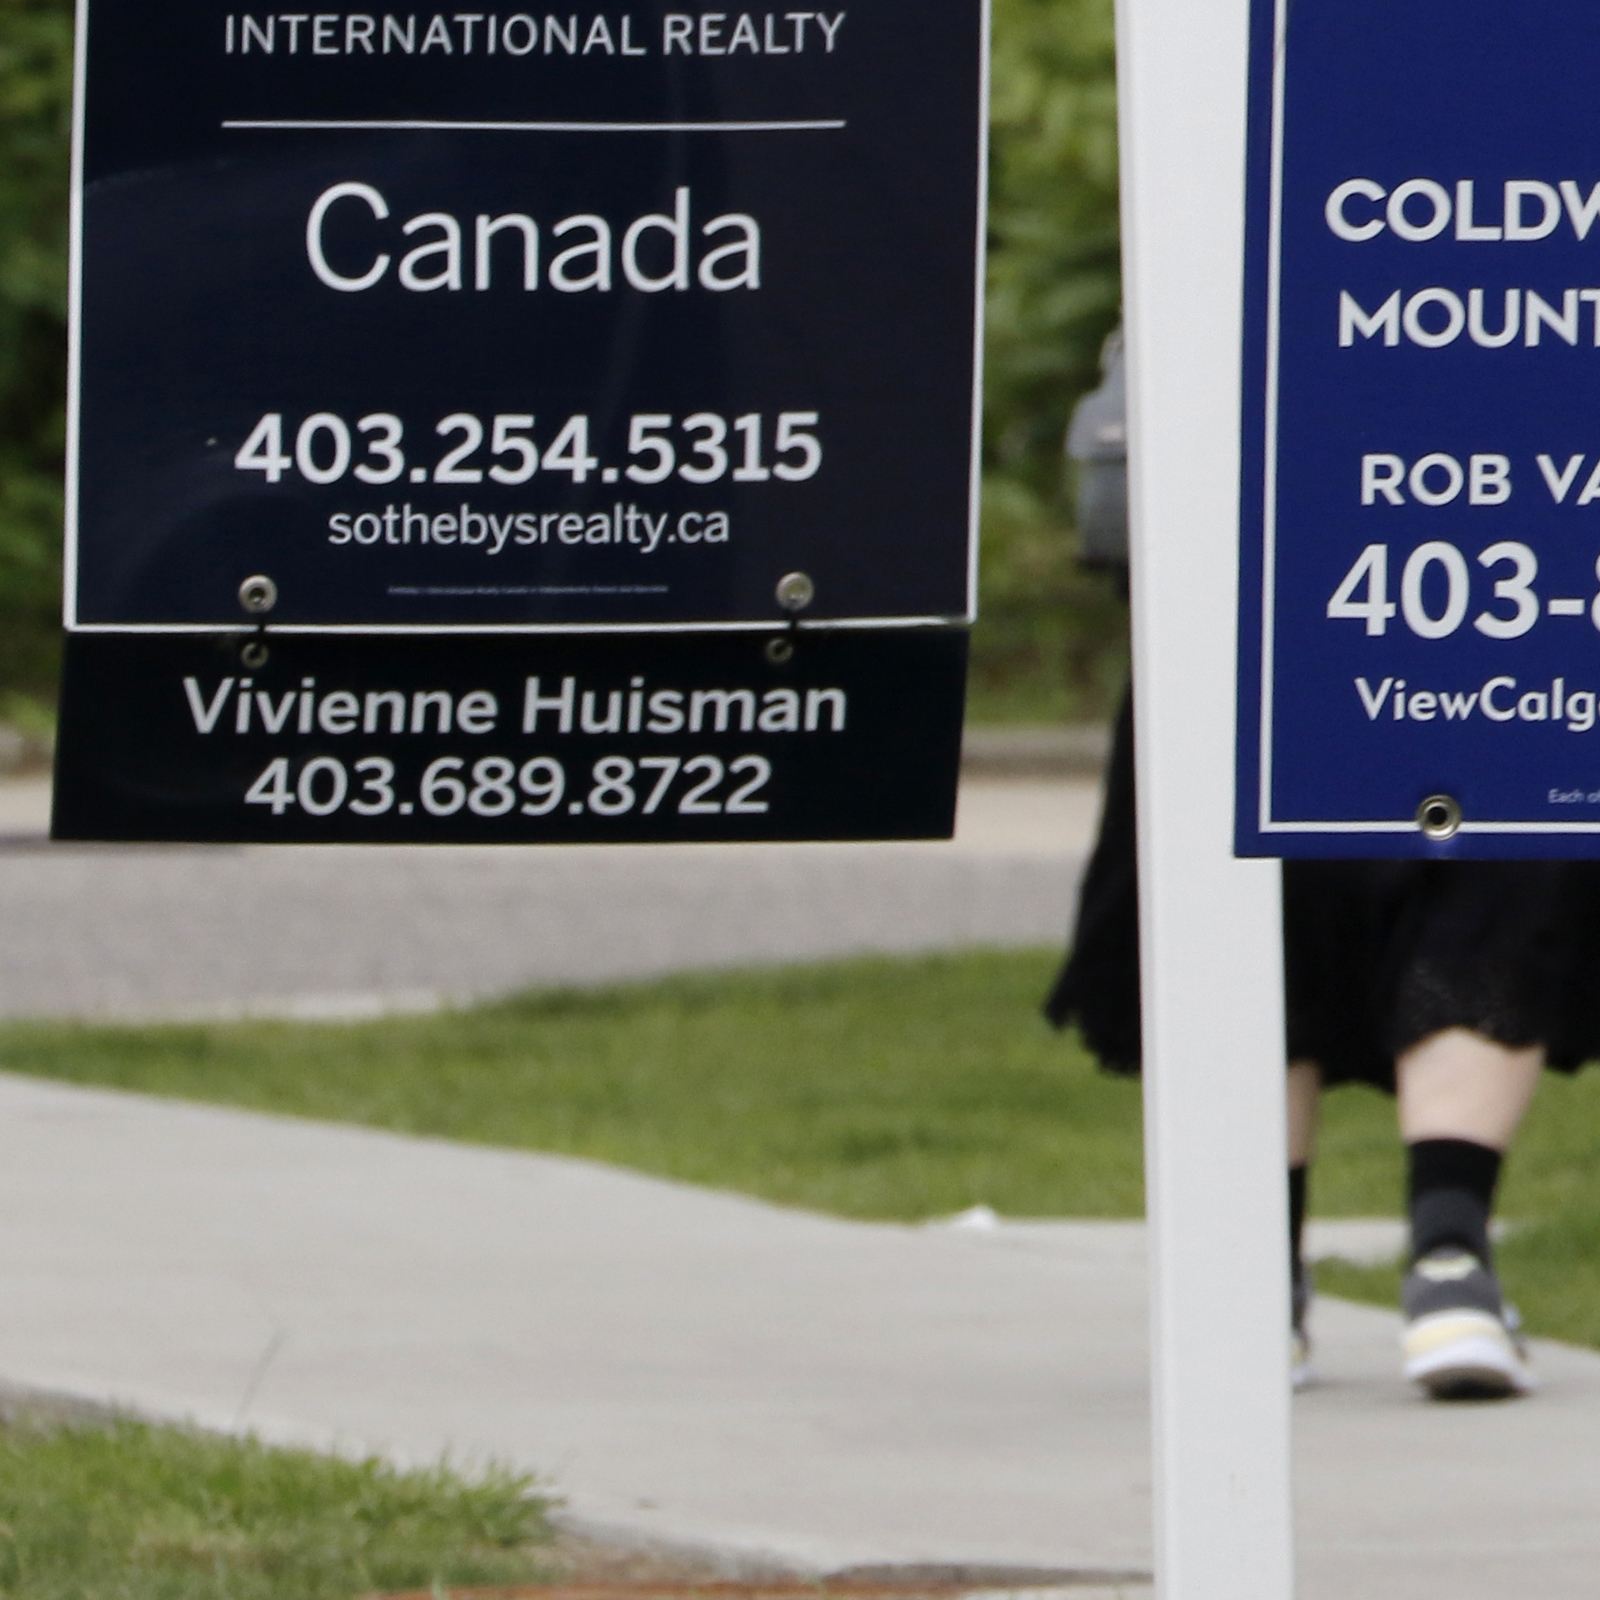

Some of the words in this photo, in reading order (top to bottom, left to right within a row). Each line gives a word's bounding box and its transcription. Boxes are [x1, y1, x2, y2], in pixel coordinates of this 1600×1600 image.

[225, 13, 646, 56] INTERNATIONAL
[663, 12, 845, 55] REALTY
[306, 182, 760, 292] Canada
[234, 411, 822, 485] 403.254.5315
[1361, 453, 1511, 506] ROB
[328, 502, 729, 555] sothebysrealty.ca
[183, 676, 498, 734] Vivienne
[522, 676, 846, 734] Huisman
[244, 755, 771, 817] 403.689.8722
[1548, 787, 1584, 805] Each
